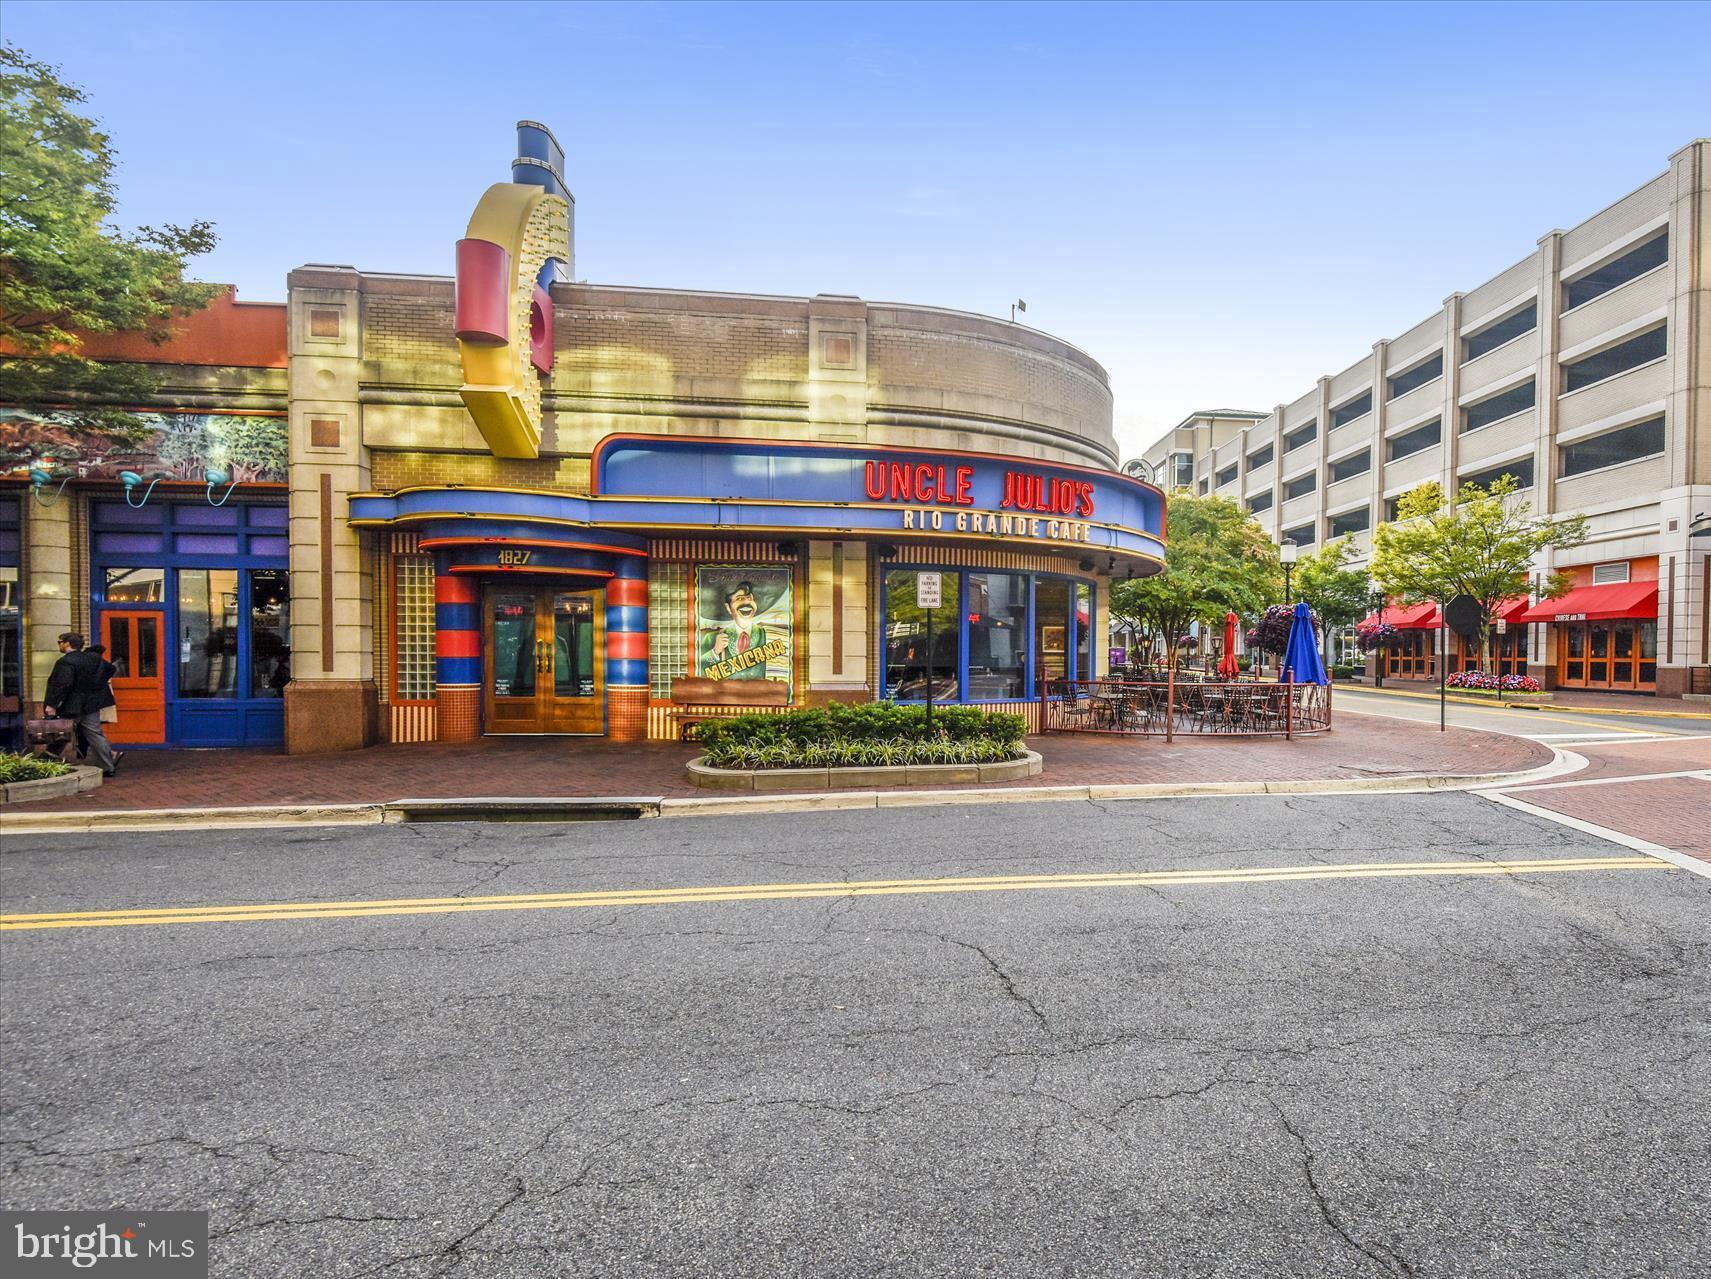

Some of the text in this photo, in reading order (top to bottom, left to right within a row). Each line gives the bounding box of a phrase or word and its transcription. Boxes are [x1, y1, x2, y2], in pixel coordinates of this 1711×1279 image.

[865, 460, 1094, 517] UNCLE JULIO'S
[903, 509, 1092, 542] RIO GRANDE CAFE
[498, 550, 532, 564] 1827
[704, 639, 786, 681] MEXICANA
